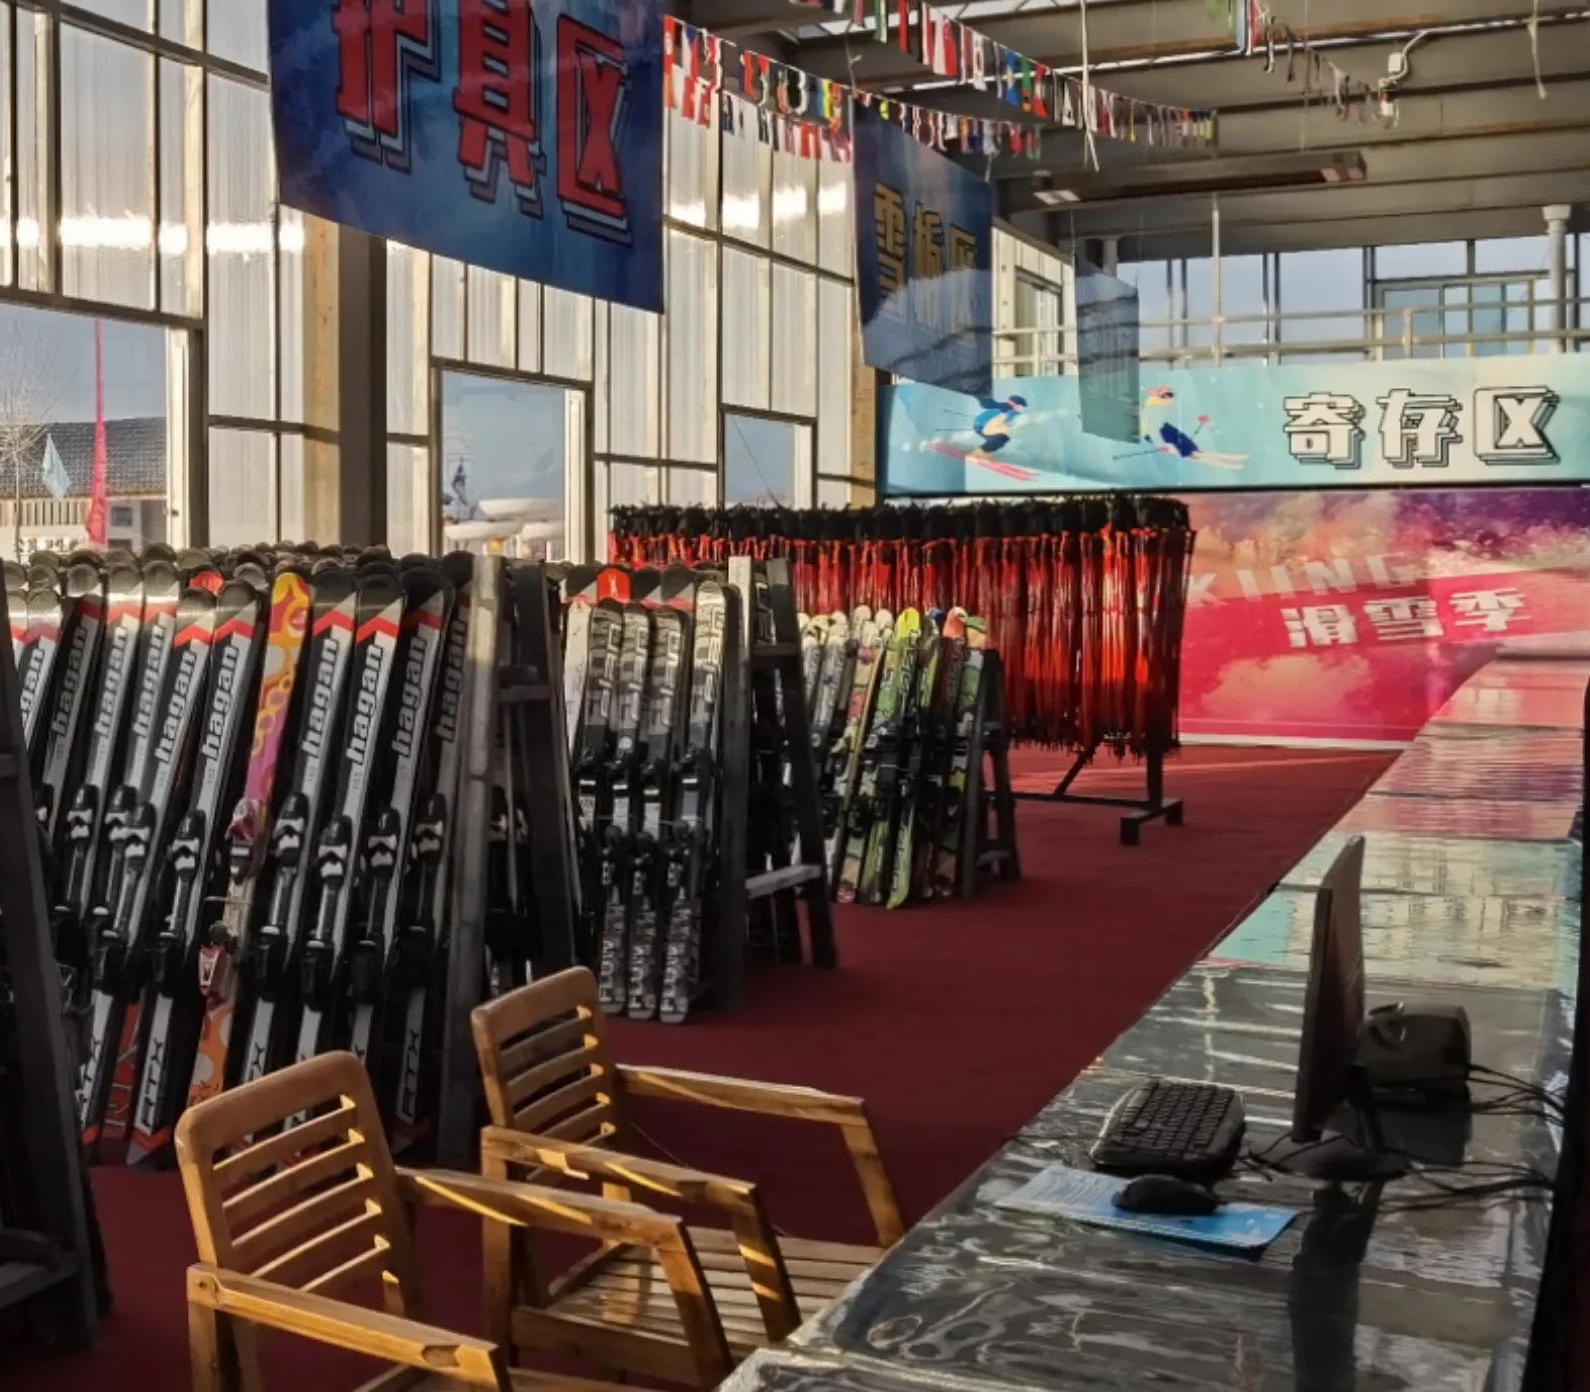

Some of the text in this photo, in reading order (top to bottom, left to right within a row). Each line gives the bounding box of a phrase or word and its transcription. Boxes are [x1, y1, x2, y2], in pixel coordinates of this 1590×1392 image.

[332, 0, 630, 238] 护具区
[1284, 385, 1560, 470] 寄存区
[1185, 552, 1426, 607] KIING
[1279, 586, 1532, 649] 滑雪季
[50, 625, 89, 737] hagan
[93, 625, 128, 739] hagan
[132, 623, 167, 739] hagan
[154, 649, 197, 765] hagan
[201, 644, 240, 762] hagan
[300, 636, 339, 759] hagan
[345, 643, 384, 766] hagan
[391, 635, 428, 759] hagan
[434, 619, 468, 744] hagan
